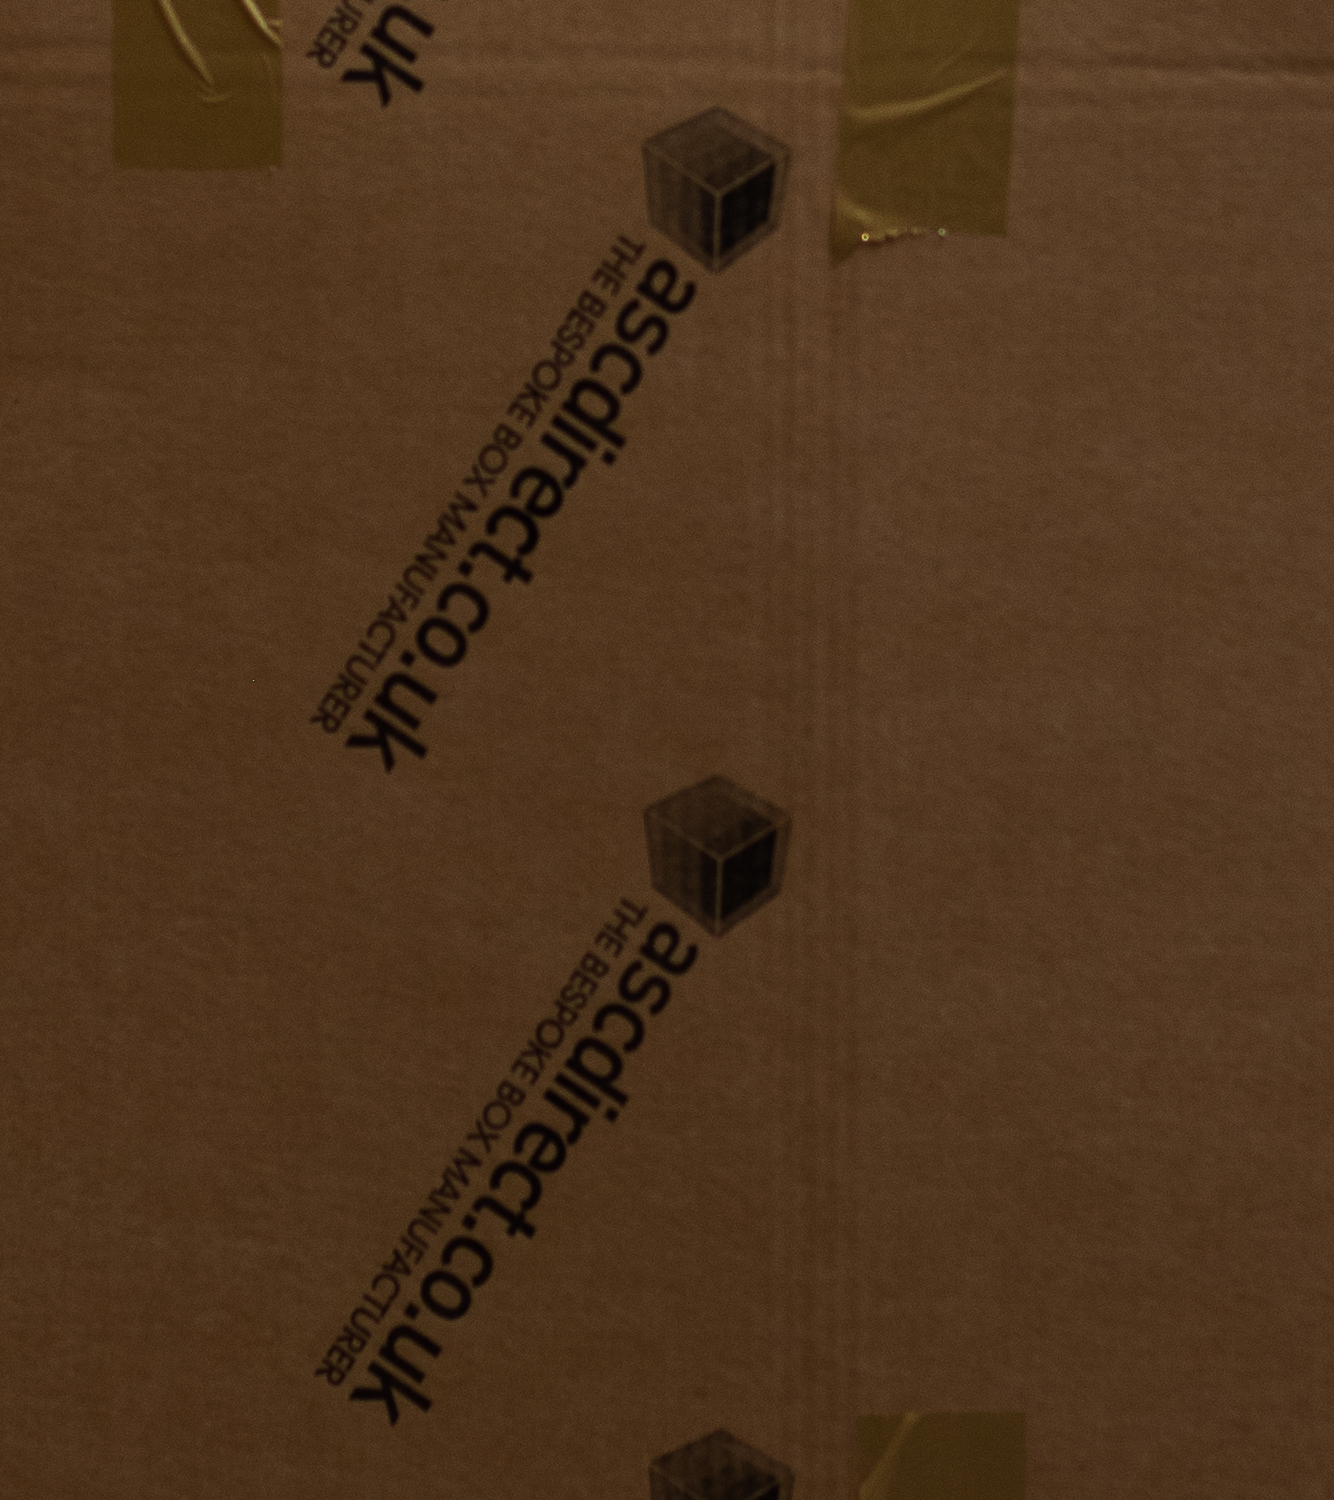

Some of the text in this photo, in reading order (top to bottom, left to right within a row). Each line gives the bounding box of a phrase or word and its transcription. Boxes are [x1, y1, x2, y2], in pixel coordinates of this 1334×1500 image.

[310, 234, 647, 734] THE BESPOKE BOX MANUFACTURER
[344, 259, 696, 774] ascdirect.co.uk
[314, 897, 649, 1387] THE BESPOKE BOX MANUFACTURER
[348, 922, 698, 1427] ascdirect.co.uk
